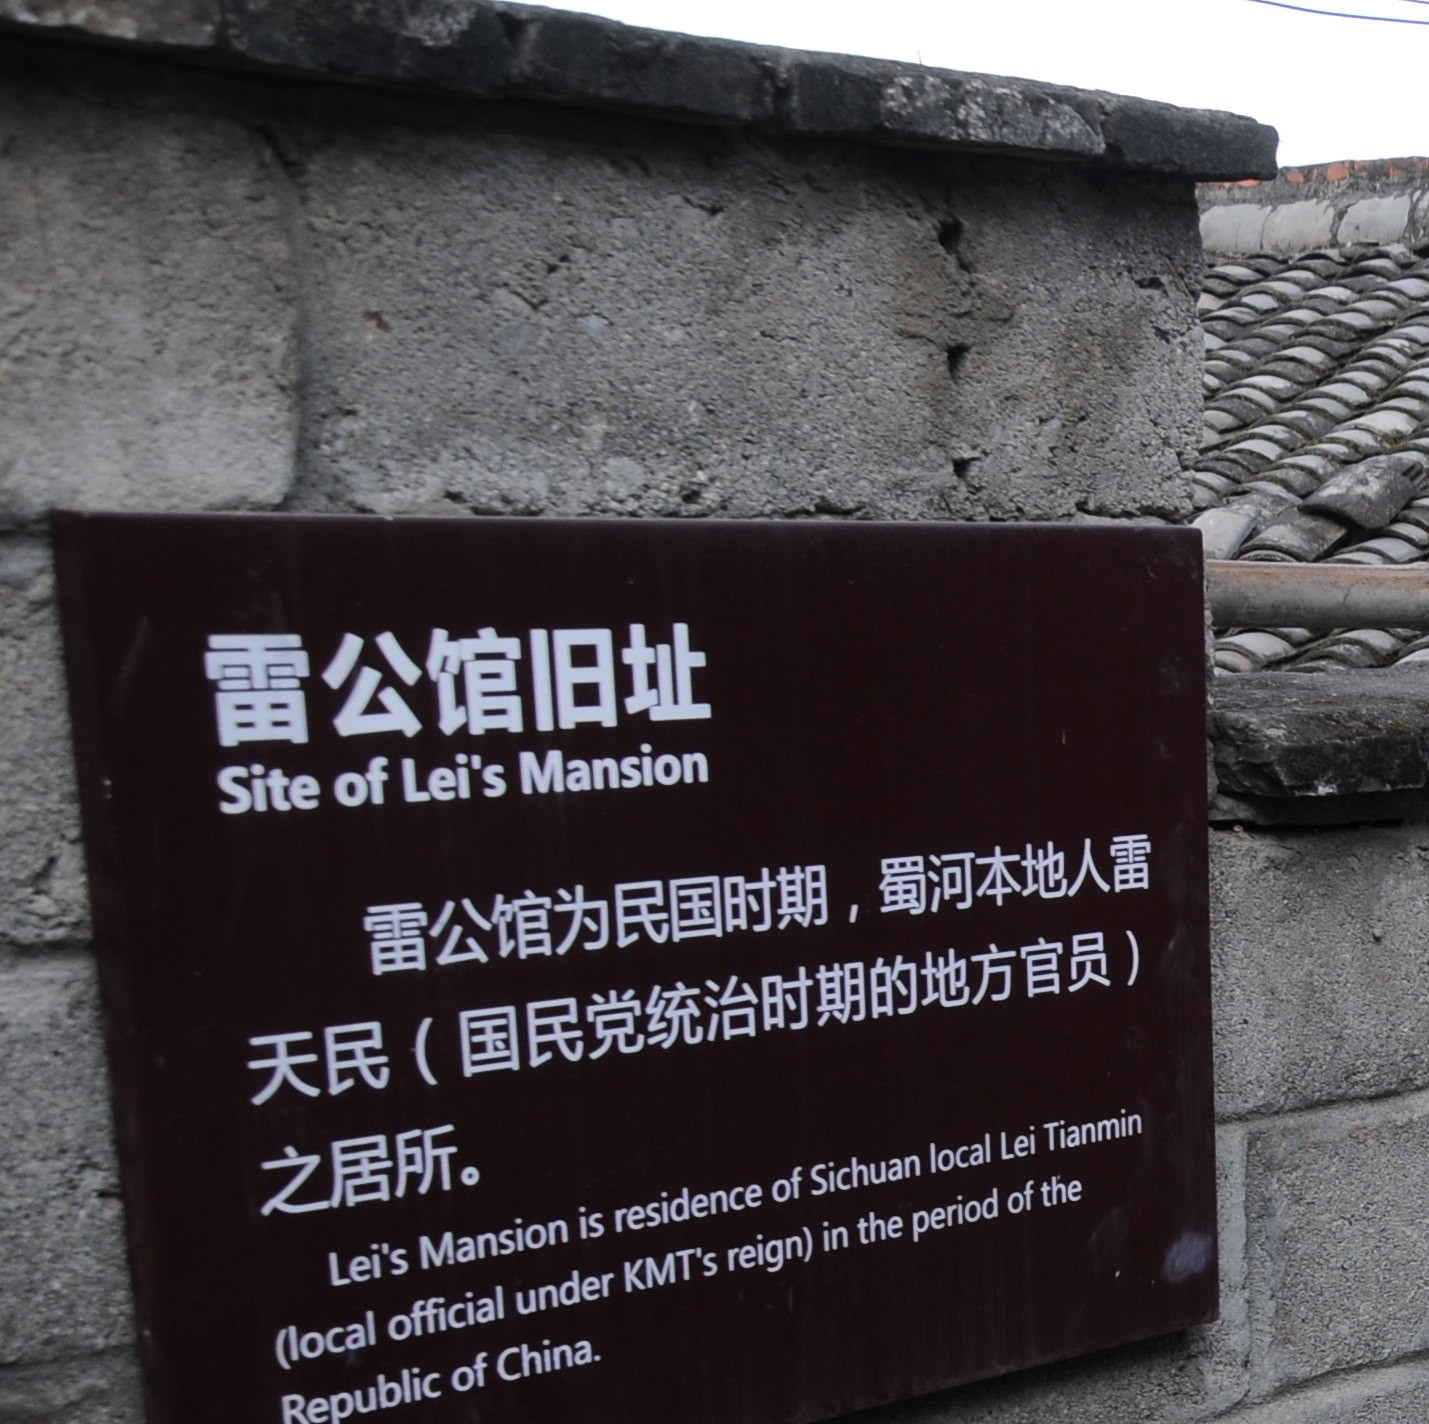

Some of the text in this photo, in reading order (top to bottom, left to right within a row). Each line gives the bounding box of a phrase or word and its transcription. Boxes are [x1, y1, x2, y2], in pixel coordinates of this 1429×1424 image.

[204, 622, 712, 747] 雷公馆旧址
[217, 743, 709, 815] Site of Lei's Mansion
[260, 1124, 480, 1216] 之居所。
[328, 1108, 1142, 1287] Lei's Mansion is residence of Sichuan local Lei Tianmin
[275, 1175, 1083, 1370] (local official under KMT's reign) in the period of the
[451, 1351, 488, 1392] of
[496, 1339, 601, 1381] China.
